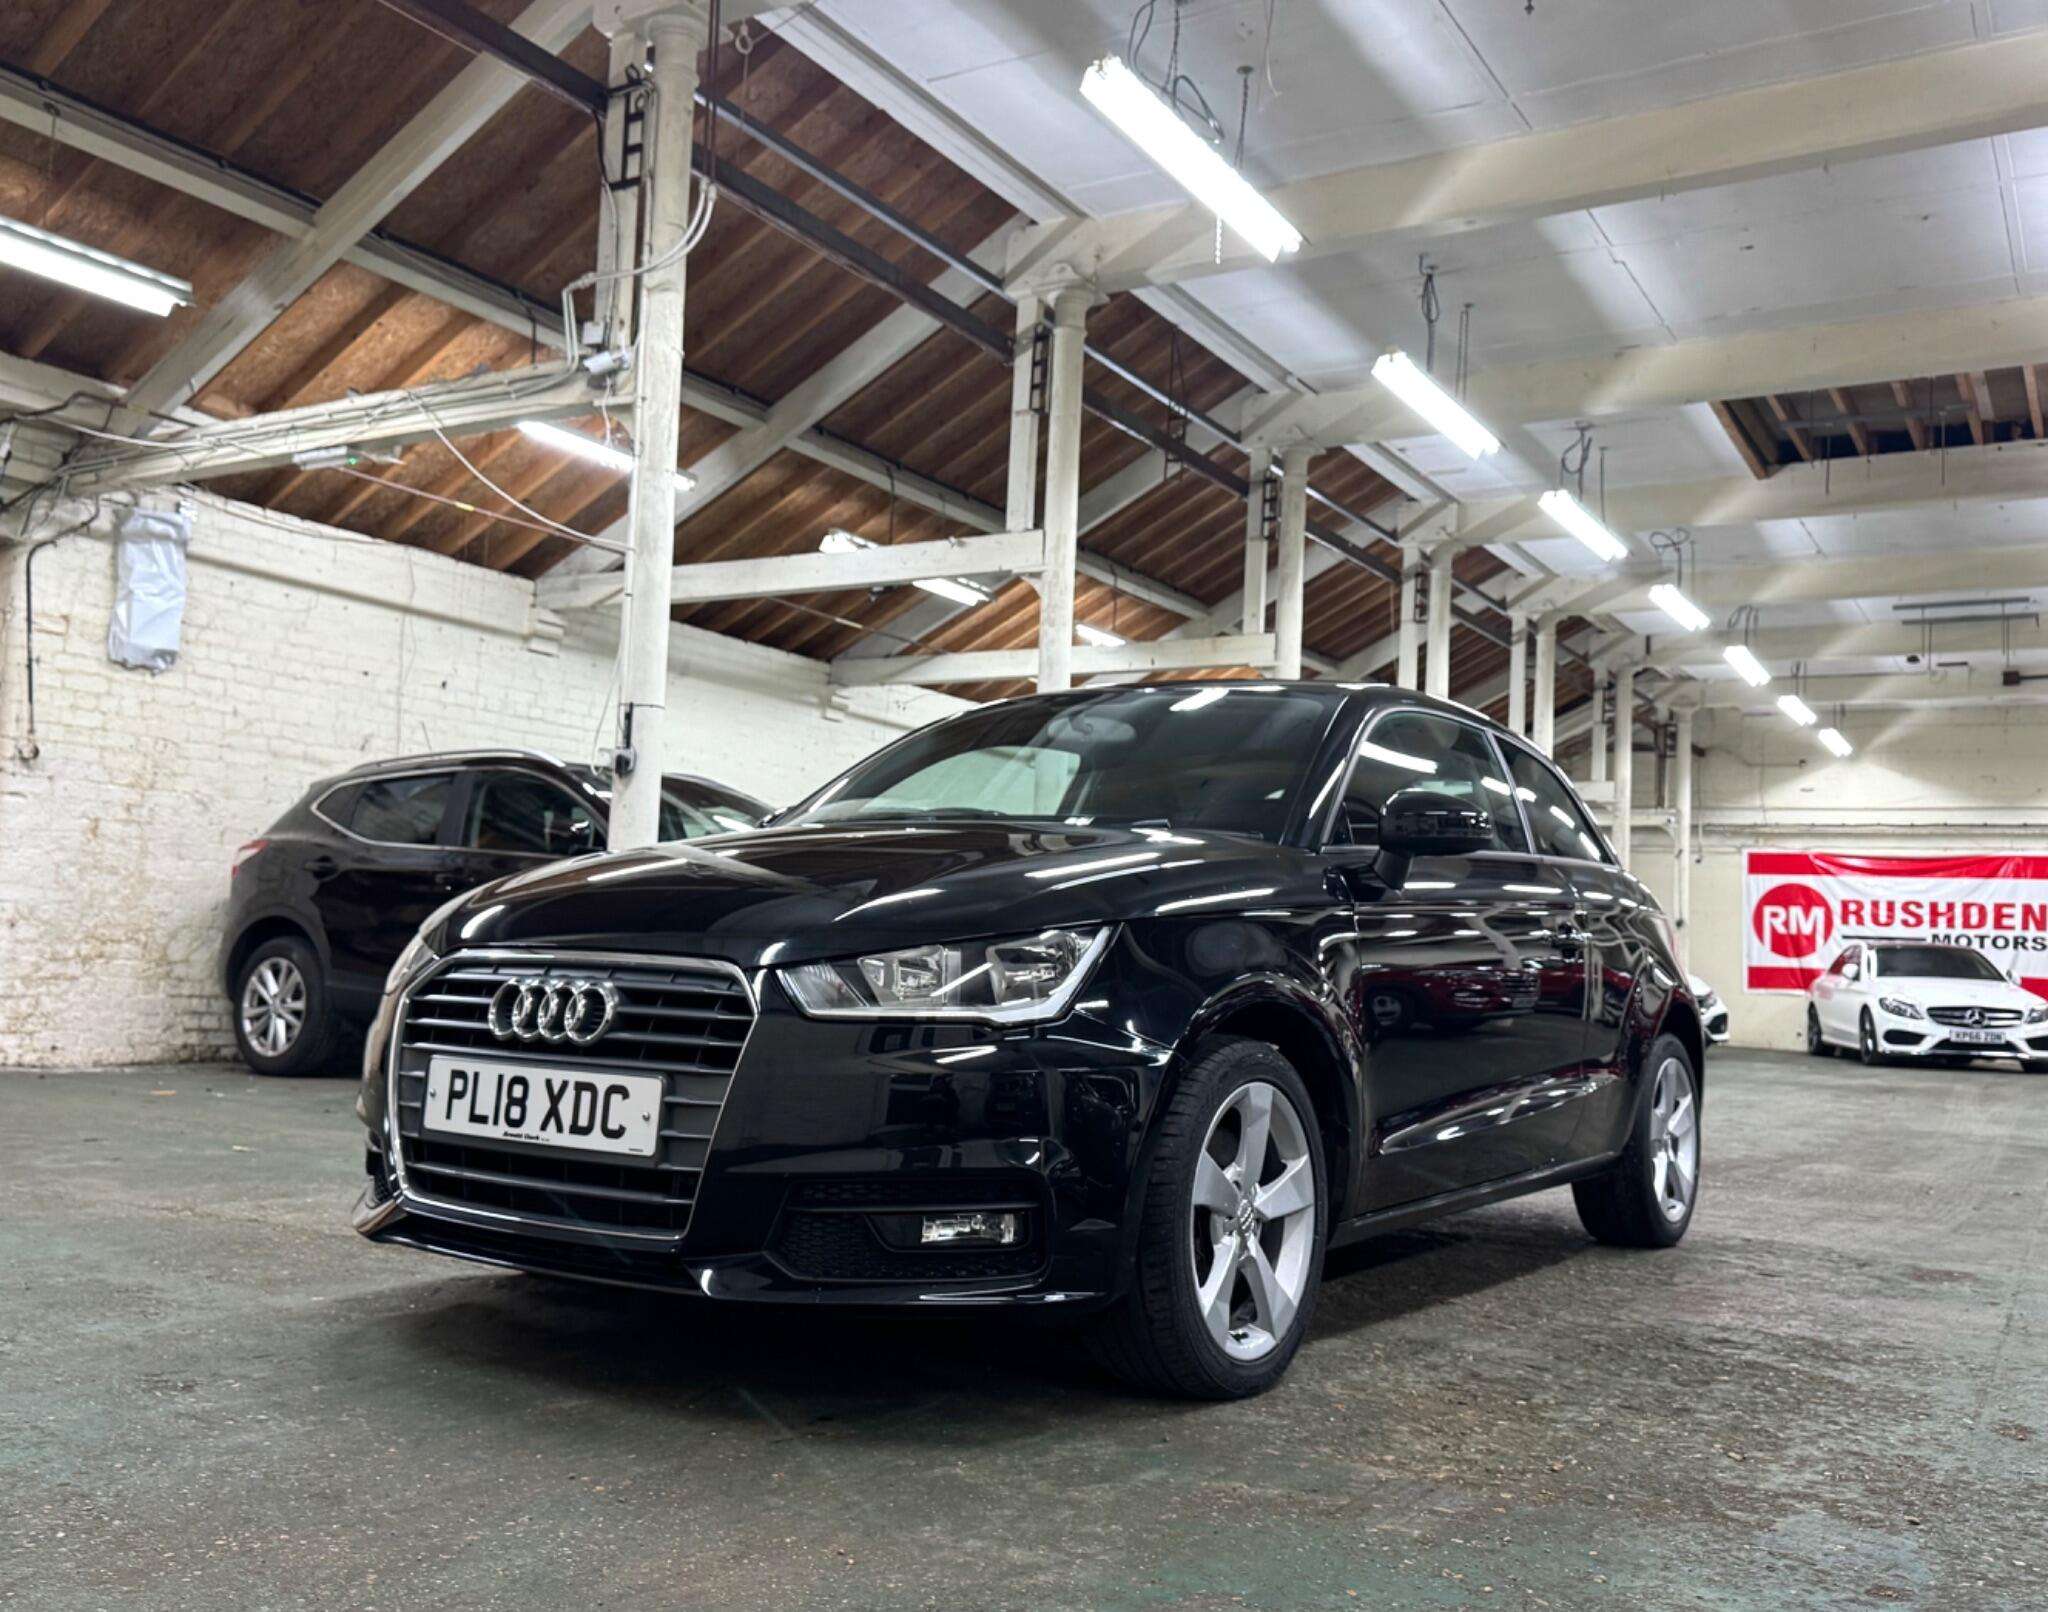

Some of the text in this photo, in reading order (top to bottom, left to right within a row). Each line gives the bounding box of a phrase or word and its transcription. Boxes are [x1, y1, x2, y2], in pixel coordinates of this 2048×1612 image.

[1762, 904, 1826, 952] RM
[1840, 899, 2047, 932] RUSHDEN
[1931, 934, 2047, 951] MOTORS
[445, 1068, 630, 1139] PL18 XDC
